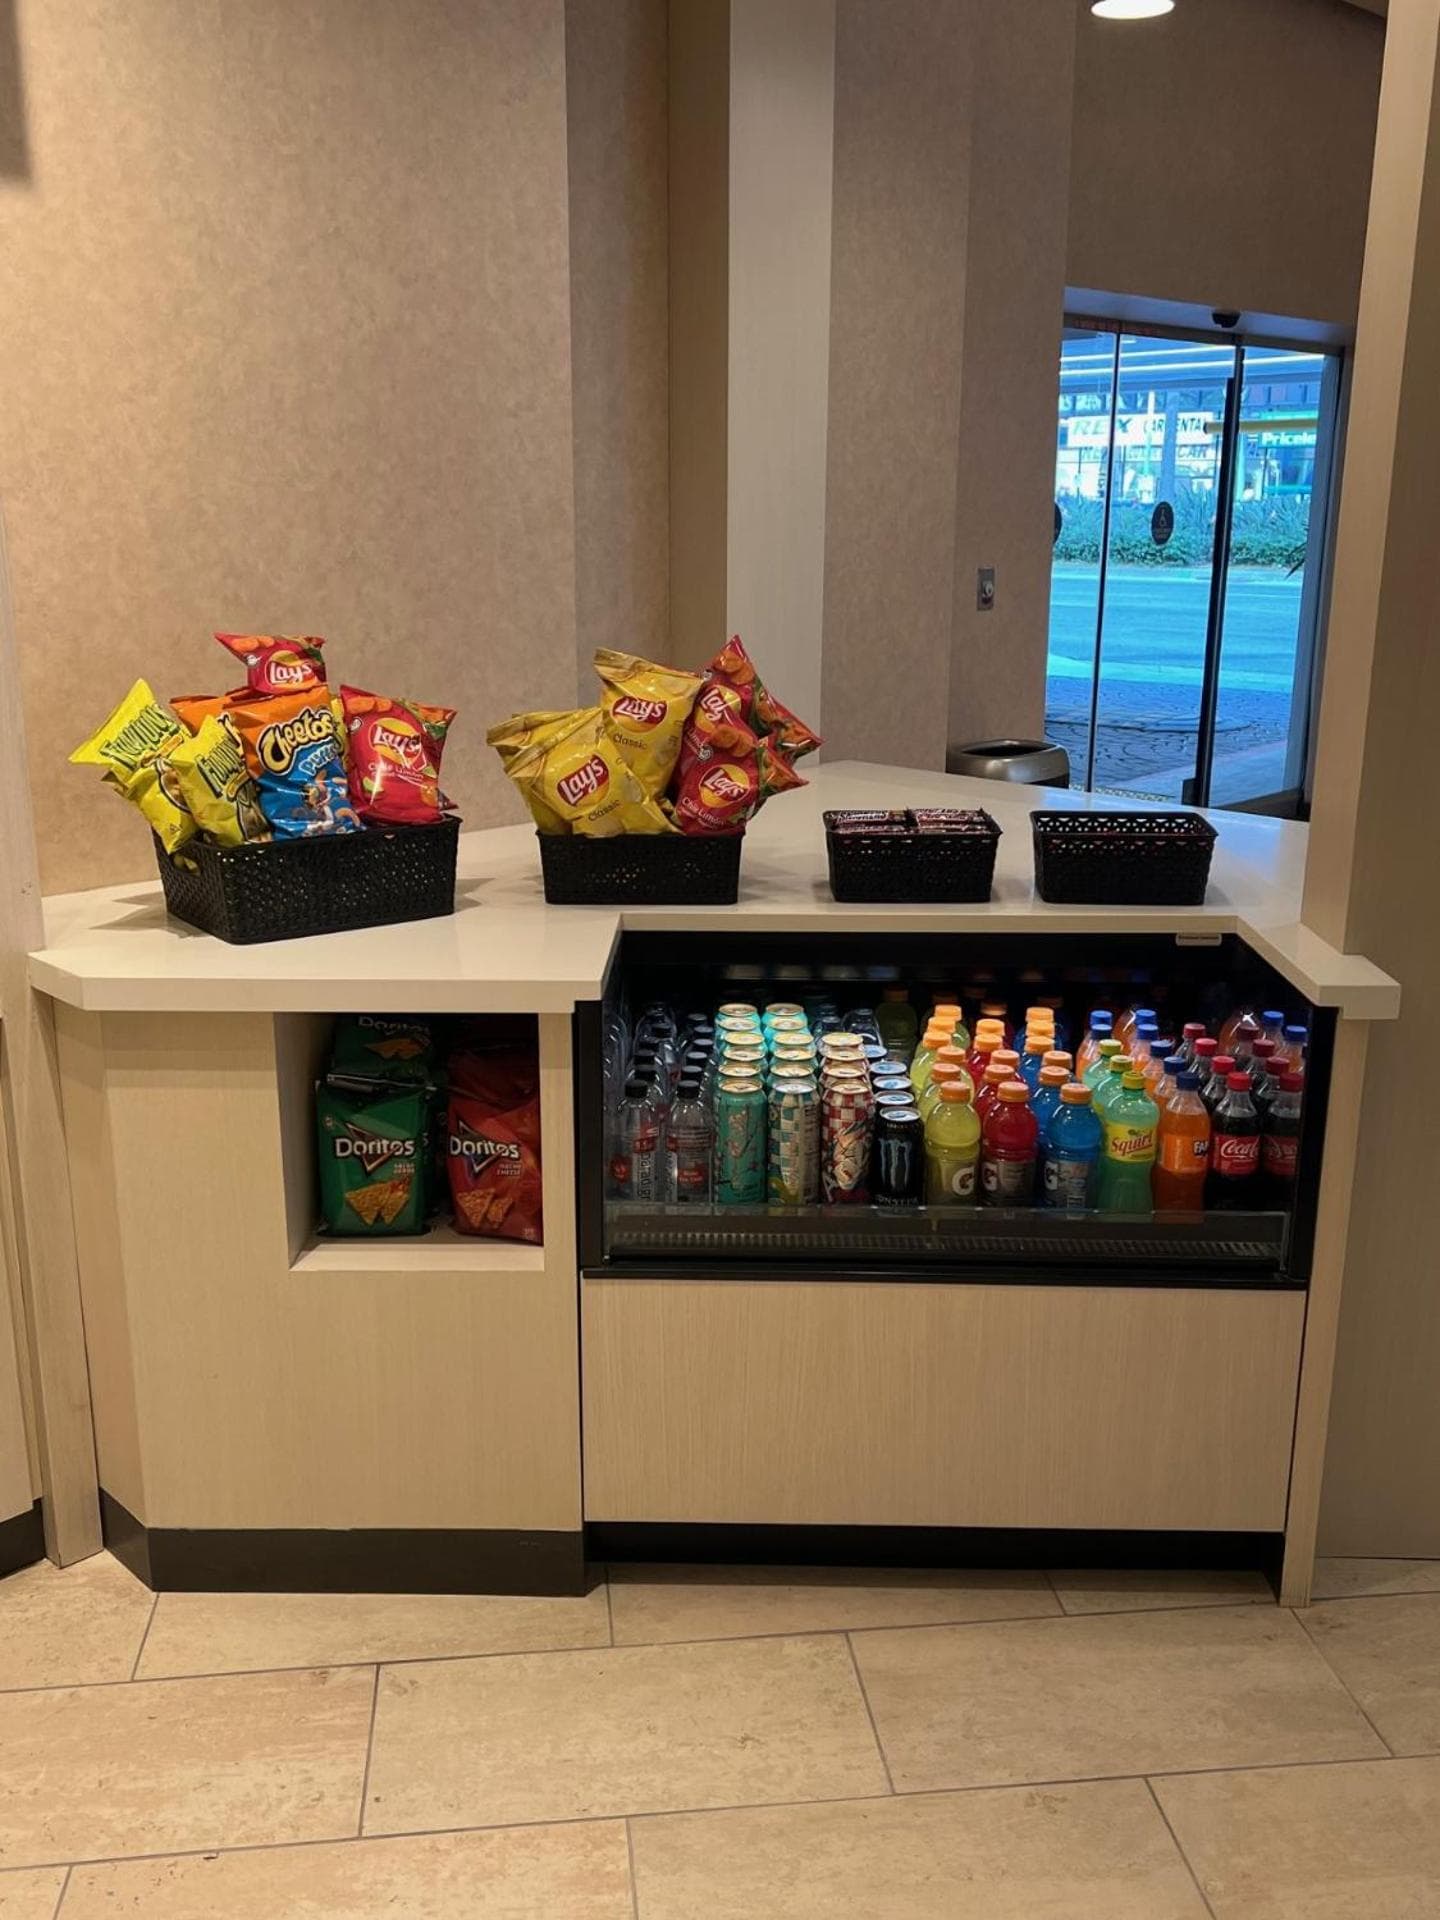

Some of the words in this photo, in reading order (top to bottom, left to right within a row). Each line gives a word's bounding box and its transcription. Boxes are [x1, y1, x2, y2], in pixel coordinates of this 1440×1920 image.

[259, 707, 334, 774] Cheetos
[335, 1137, 416, 1158] Doritos
[450, 1135, 521, 1159] Doritos
[1110, 1131, 1154, 1156] Squirt
